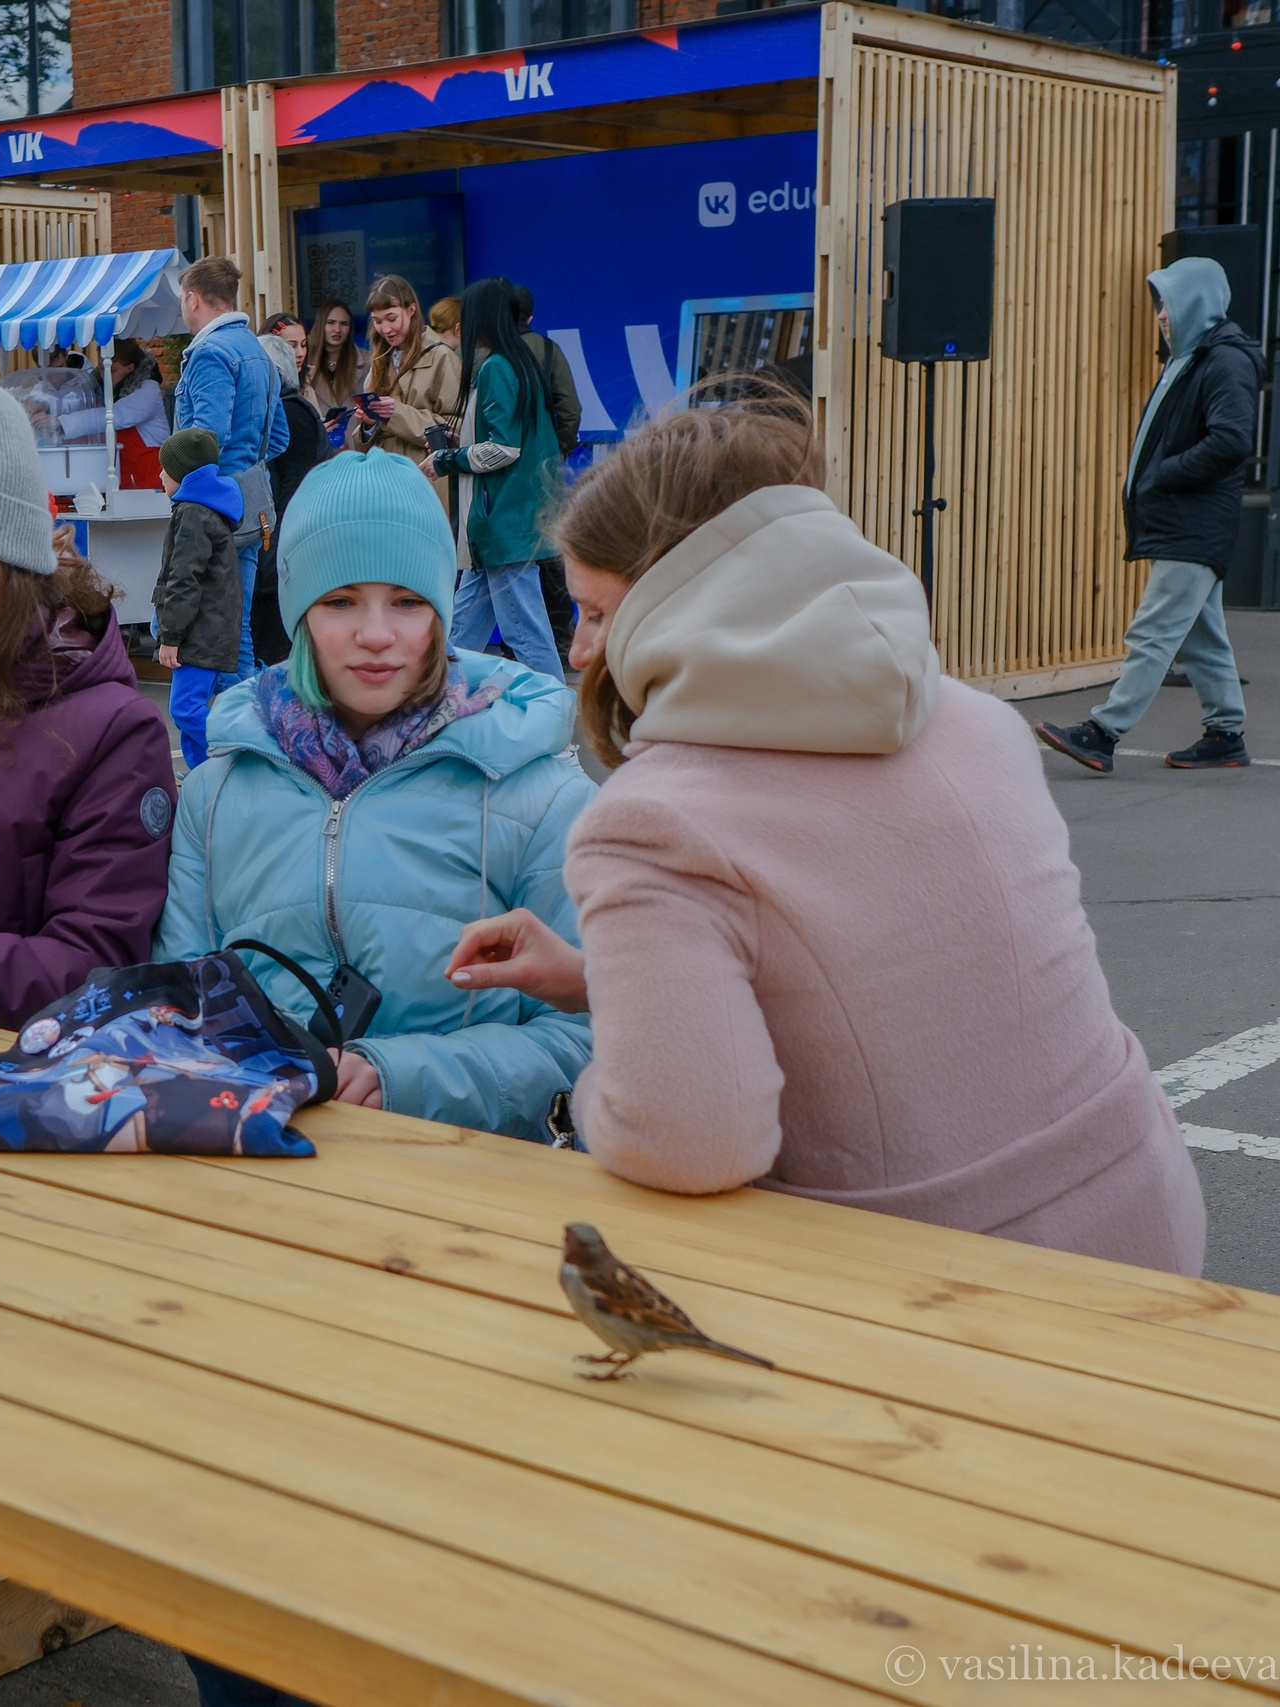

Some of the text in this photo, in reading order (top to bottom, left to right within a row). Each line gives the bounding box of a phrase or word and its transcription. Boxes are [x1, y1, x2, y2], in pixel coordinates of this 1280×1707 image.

[504, 62, 554, 101] VK
[8, 131, 44, 163] VK
[748, 181, 817, 213] edu
